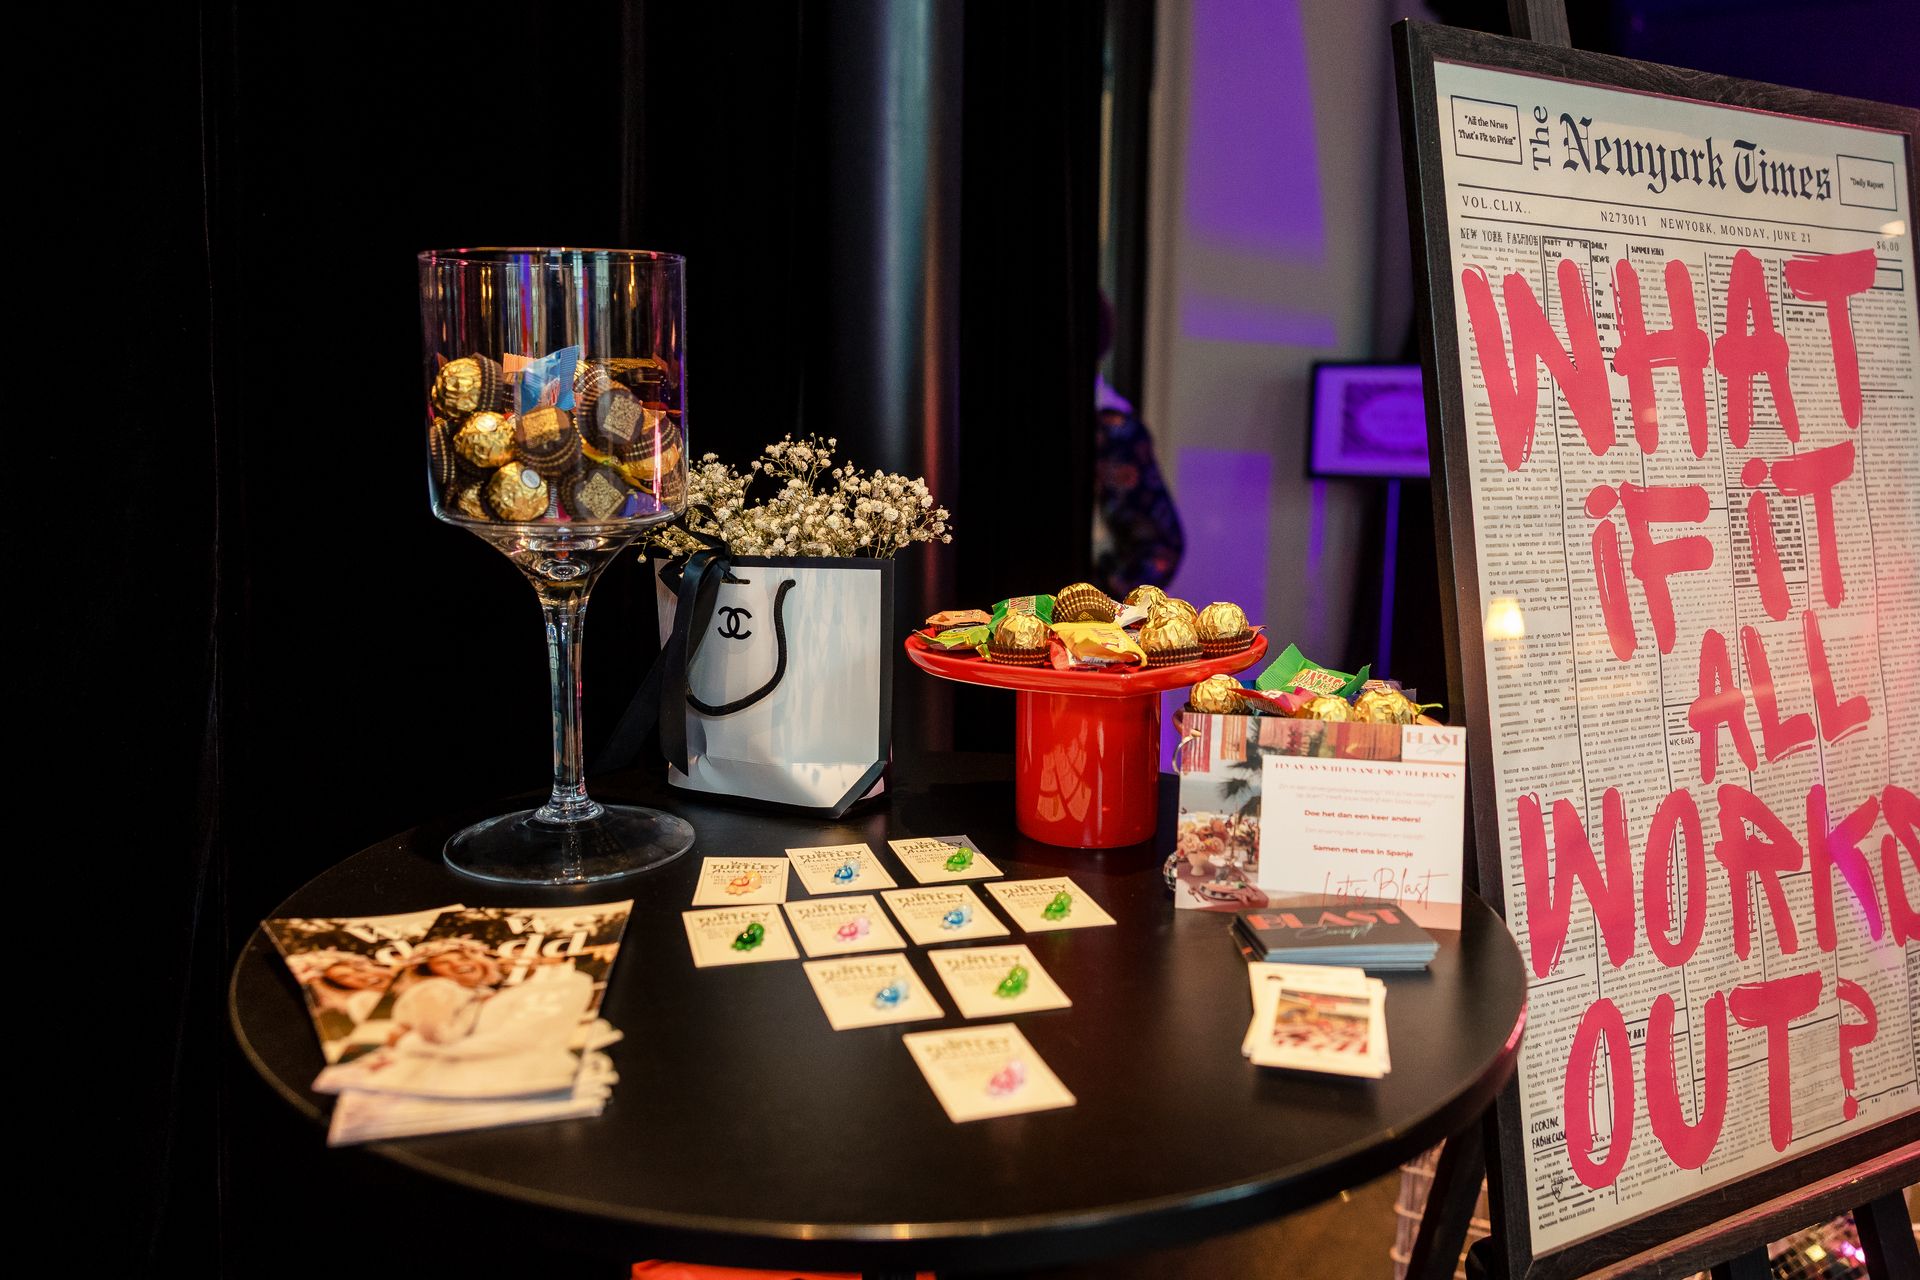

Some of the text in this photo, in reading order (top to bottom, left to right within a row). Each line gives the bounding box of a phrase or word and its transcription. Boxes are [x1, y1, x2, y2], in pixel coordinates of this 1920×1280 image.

[1529, 105, 1551, 170] The
[1560, 112, 1831, 200] Newyork Times
[1460, 227, 1477, 239] NEW
[1600, 210, 1647, 227] N273011
[1720, 224, 1769, 241] MONDAY,
[1773, 230, 1796, 242] JUNE
[1801, 233, 1811, 243] 21
[1461, 248, 1878, 471] WHAT
[1688, 610, 1871, 784] ALL
[1313, 844, 1340, 853] Samen
[1342, 846, 1358, 854] met
[1386, 849, 1414, 859] Spanje
[1564, 970, 1879, 1190] OUT?
